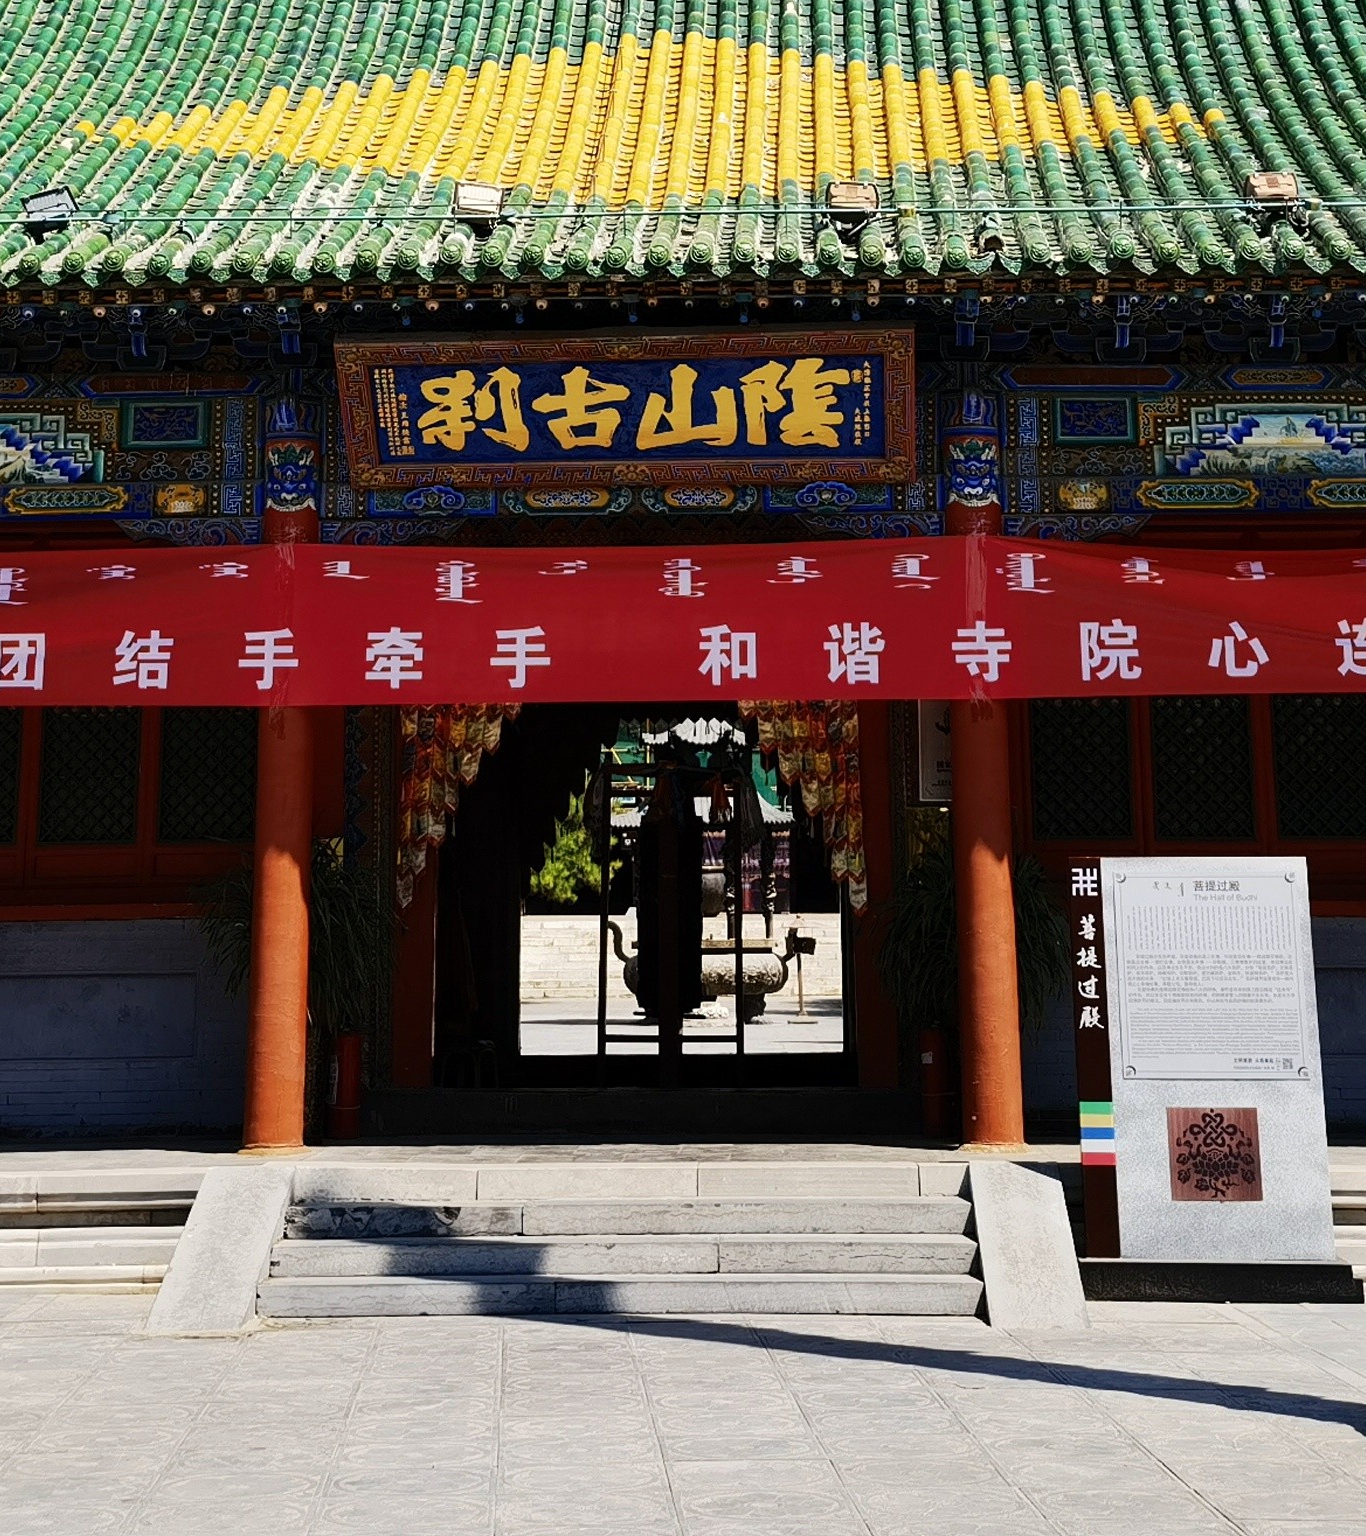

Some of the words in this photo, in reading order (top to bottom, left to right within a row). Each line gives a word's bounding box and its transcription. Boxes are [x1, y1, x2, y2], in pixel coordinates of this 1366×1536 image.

[1192, 880, 1240, 892] 菩提过殿
[1193, 893, 1208, 901] The
[1076, 914, 1105, 1030] 菩提过殿
